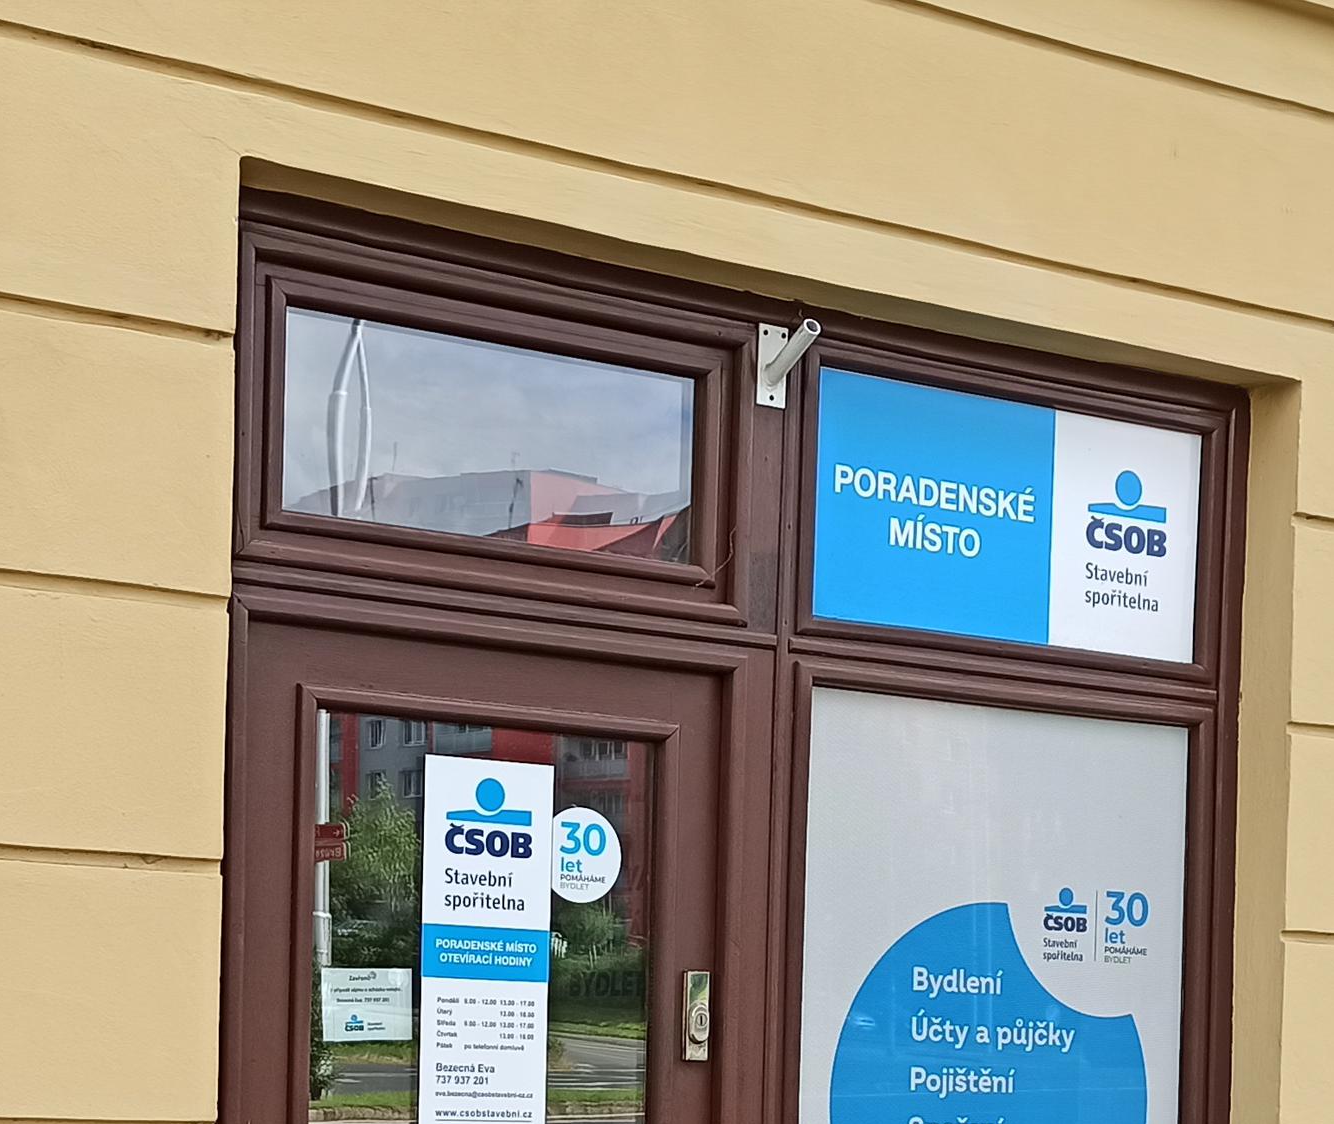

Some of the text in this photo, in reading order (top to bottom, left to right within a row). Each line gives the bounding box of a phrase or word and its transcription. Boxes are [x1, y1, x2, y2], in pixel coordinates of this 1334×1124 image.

[834, 463, 1036, 524] PORADENSKÉ
[888, 514, 982, 558] MÍSTO
[1085, 515, 1167, 558] ČSOB
[1085, 562, 1149, 587] Stavební
[1084, 589, 1160, 612] spořitelna
[444, 822, 533, 859] ČSOB
[559, 821, 607, 856] 30
[560, 856, 583, 873] let
[444, 867, 514, 888] Stavební
[560, 873, 606, 884] POMÁHÁME
[560, 881, 590, 890] BYDLET
[444, 891, 525, 911] spořitelna
[1104, 891, 1149, 927] 30
[1043, 913, 1087, 932] ČSOB
[1043, 937, 1078, 949] Stavební
[1104, 927, 1126, 944] let
[435, 938, 537, 954] PORADENSKÉ MÍSTO
[1104, 946, 1148, 956] POMÁHÁME
[439, 951, 533, 968] OTEVÍRACÍ HODINY
[1043, 951, 1084, 962] spořitelna
[1104, 955, 1132, 964] BYDLET
[912, 966, 1004, 999] Bydlení
[911, 1009, 1075, 1053] Účty a půjčky
[435, 1062, 495, 1073] Bezecná Eva
[435, 1075, 488, 1085] 737 937 201
[909, 1066, 1015, 1099] Pojištění
[435, 1109, 533, 1118] www.csobstavebni.cz
